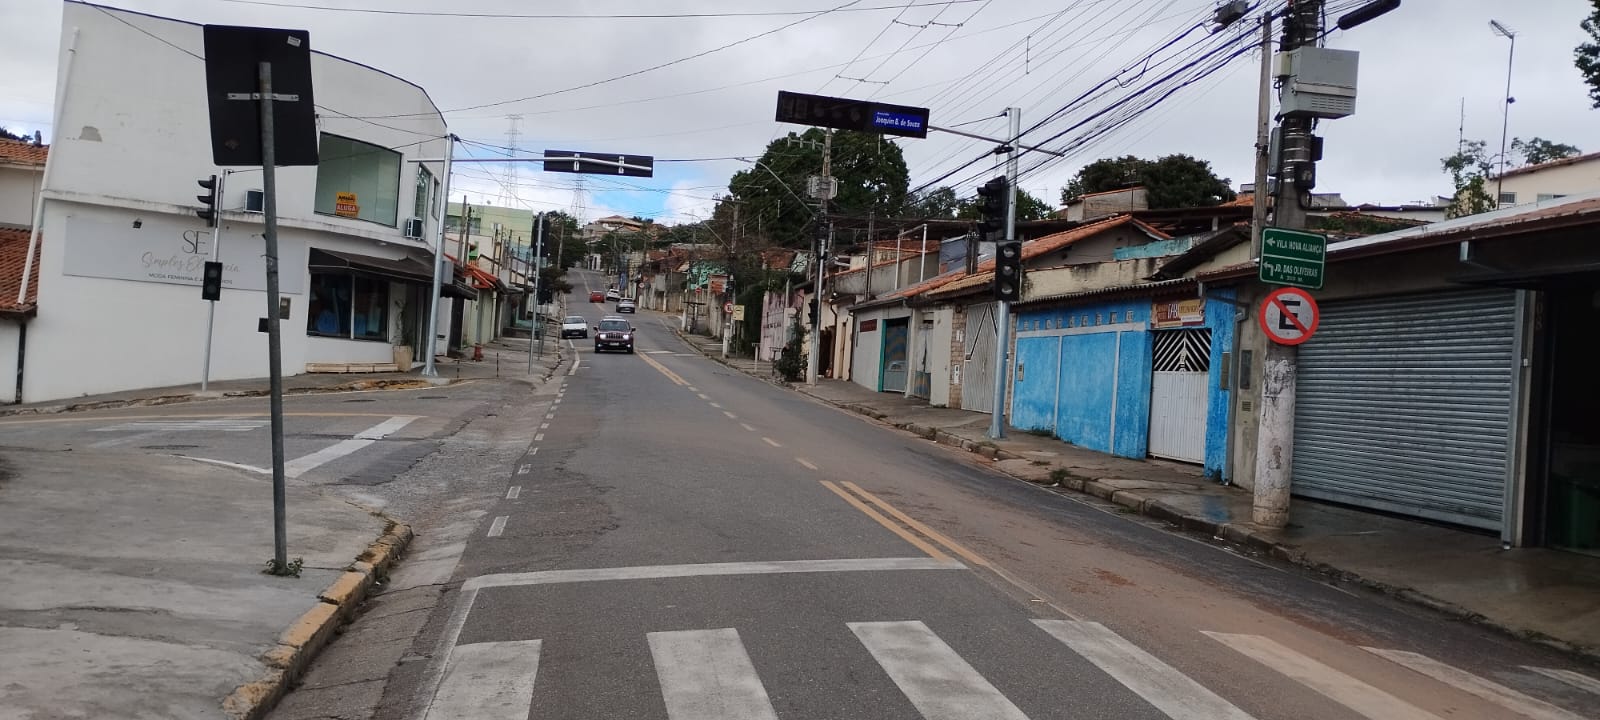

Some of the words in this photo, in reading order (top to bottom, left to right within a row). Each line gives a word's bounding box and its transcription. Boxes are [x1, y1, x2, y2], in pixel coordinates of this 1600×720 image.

[876, 116, 894, 125] Joaquim
[907, 120, 920, 128] Souza
[183, 229, 209, 255] SE
[1277, 240, 1288, 248] VILA
[1288, 240, 1302, 250] NOVA
[1302, 243, 1322, 254] ALIANÇA
[141, 251, 184, 271] Simples
[1283, 265, 1292, 274] DAS
[1294, 266, 1318, 276] OLIVEIRAS
[1279, 300, 1301, 330] E
